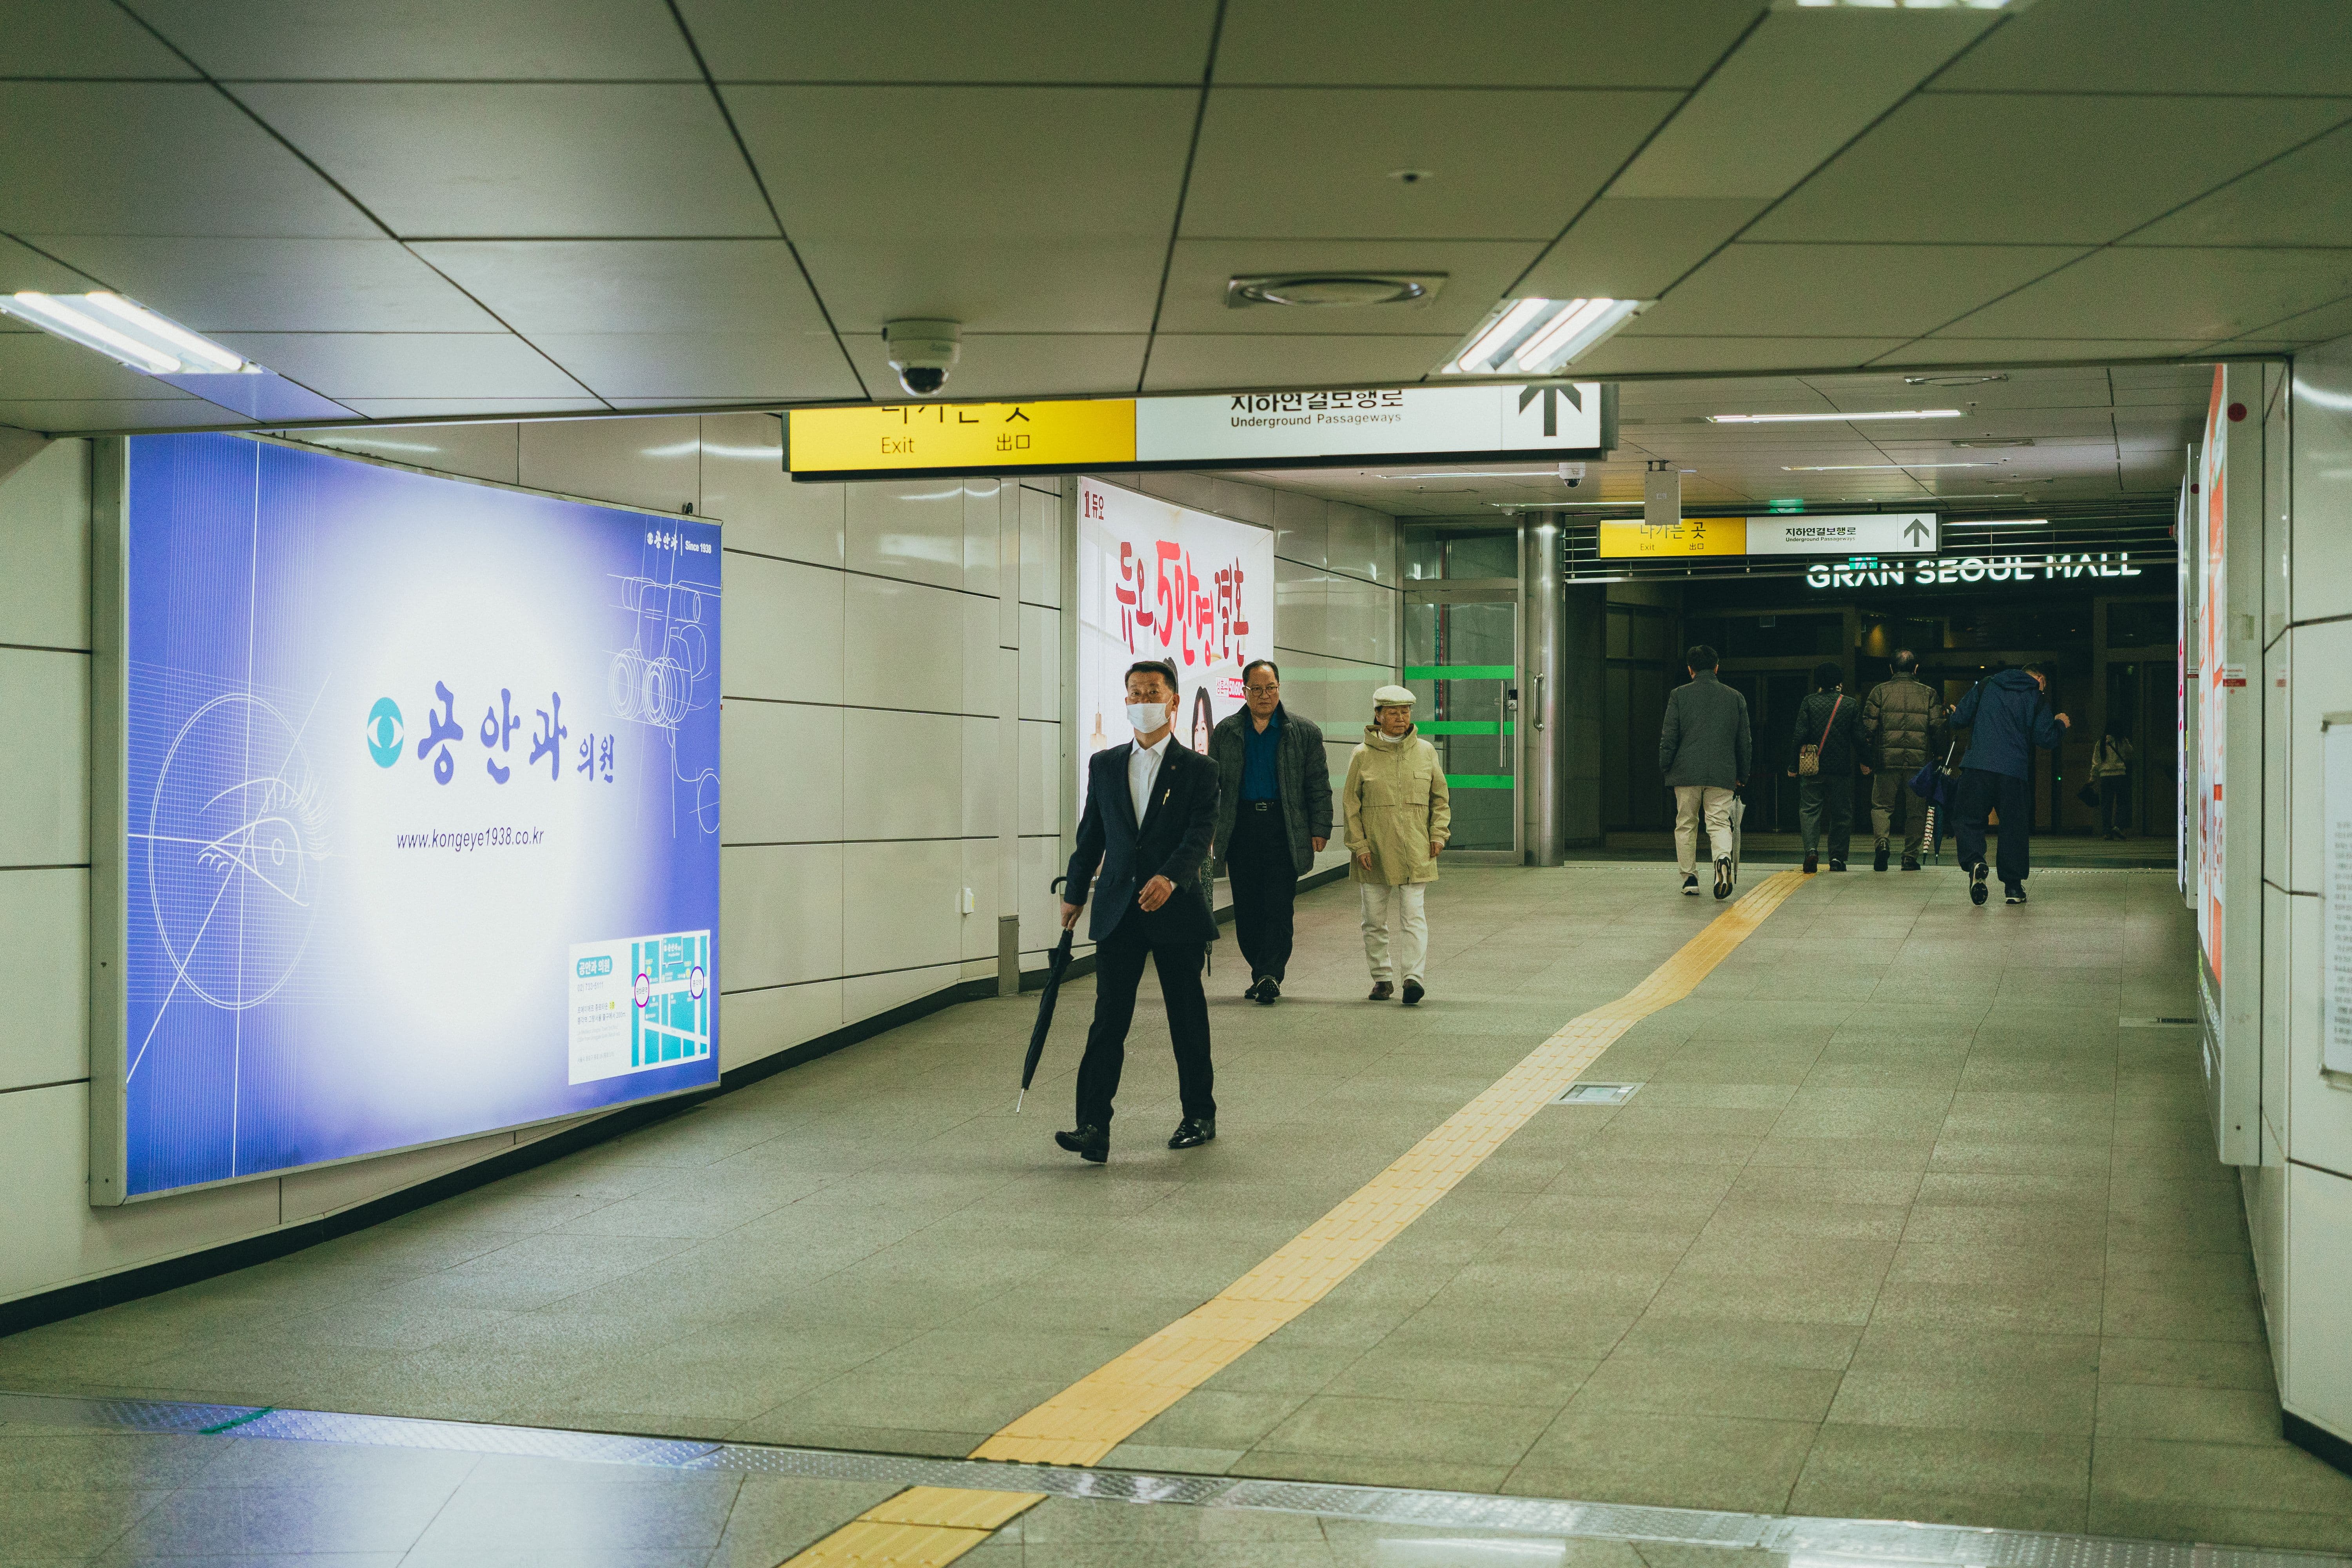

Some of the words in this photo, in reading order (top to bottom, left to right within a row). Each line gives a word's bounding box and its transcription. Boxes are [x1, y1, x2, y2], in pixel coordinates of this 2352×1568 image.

[1231, 415, 1311, 428] Underground
[1318, 413, 1401, 425] Passageways
[882, 437, 914, 454] Exit
[997, 434, 1030, 450] 出口
[1691, 522, 1706, 539] 곳
[1786, 527, 1856, 536] 지하연결보행로
[654, 530, 678, 551] 공안과
[685, 540, 699, 552] Since
[700, 543, 711, 554] 1938
[1807, 562, 1904, 588] GRAN
[1915, 557, 2034, 584] SEOUL
[2046, 553, 2141, 578] MALL
[1215, 556, 1249, 667] 결혼
[417, 680, 567, 785] 공안과
[577, 733, 614, 783] 의원
[397, 827, 544, 851] www.kongeye1938.co.kr
[579, 960, 597, 976] 공안과
[598, 958, 610, 973] 의원
